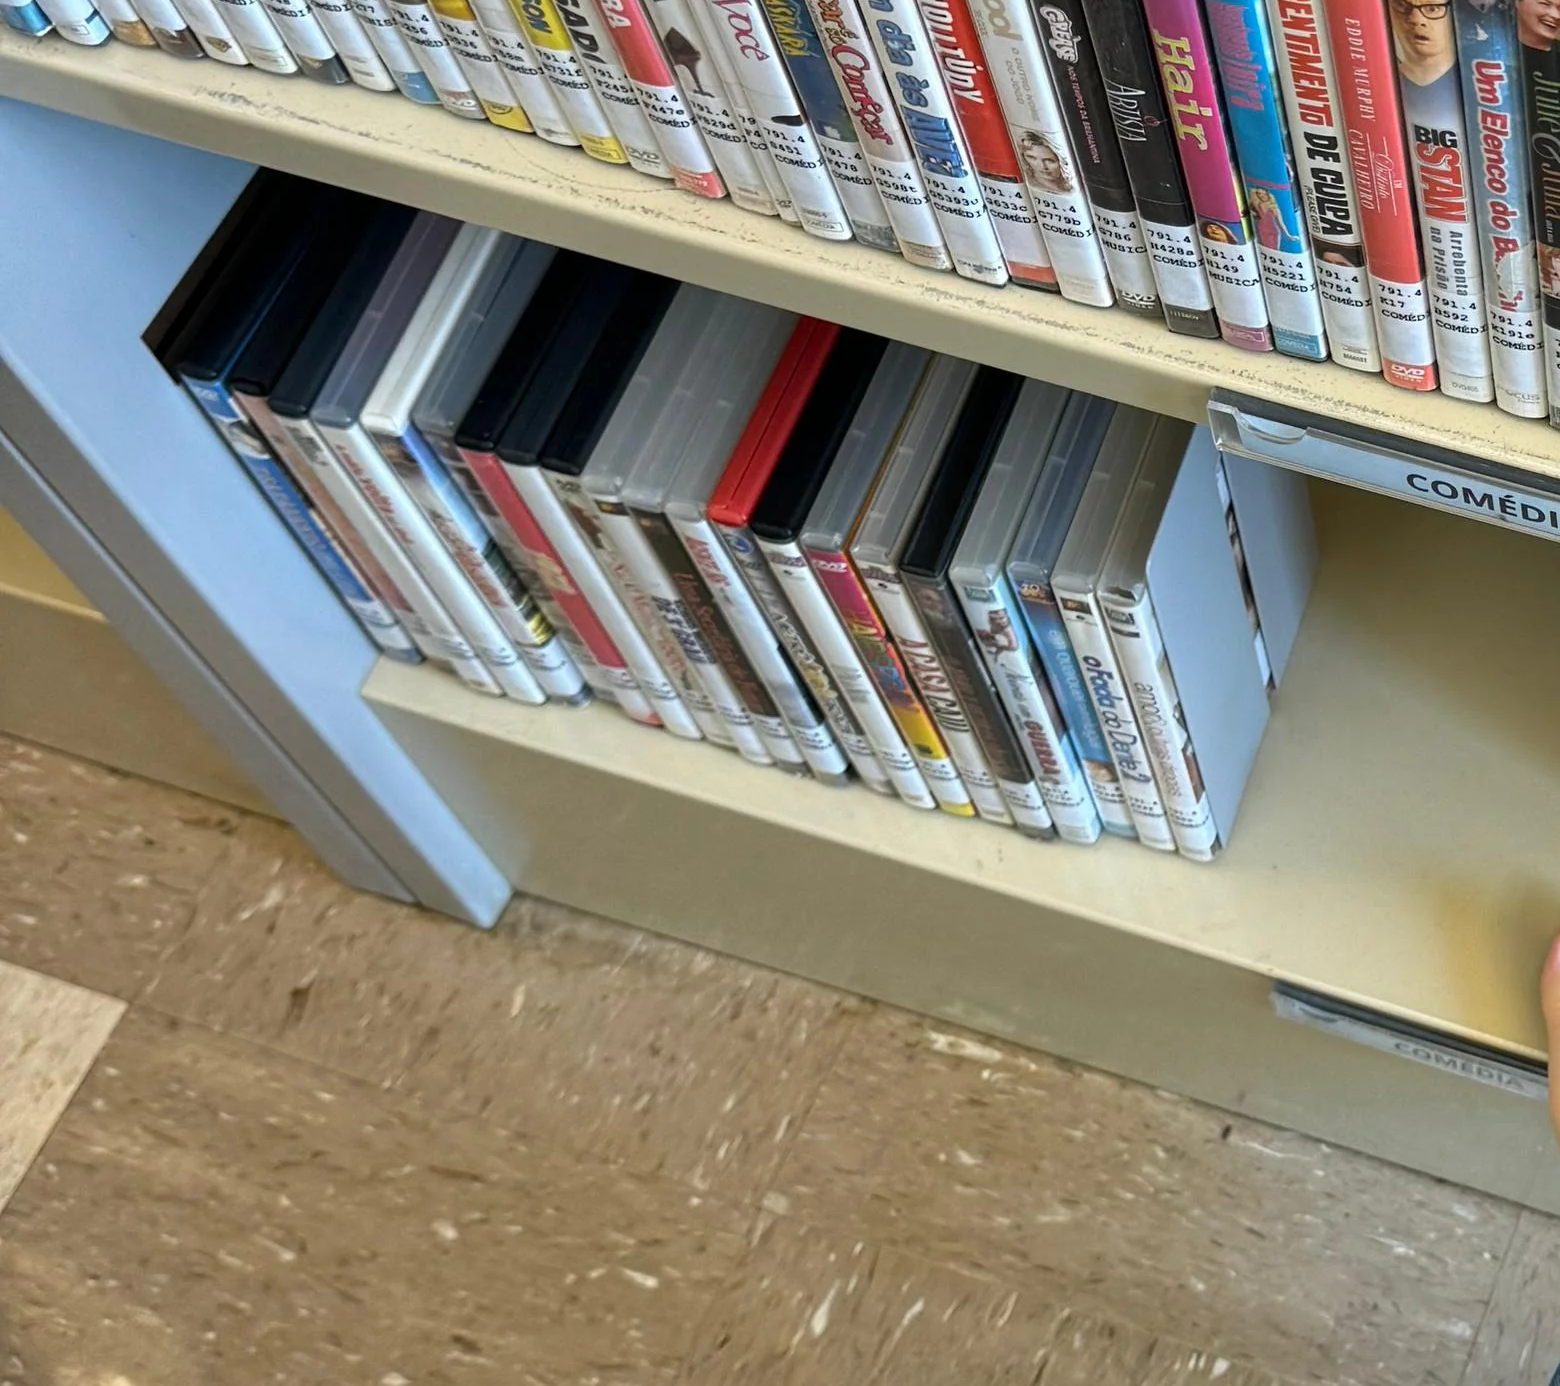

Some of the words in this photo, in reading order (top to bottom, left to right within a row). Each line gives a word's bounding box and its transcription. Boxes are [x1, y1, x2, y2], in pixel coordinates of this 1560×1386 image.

[877, 19, 916, 66] dia
[1345, 17, 1365, 63] EDDIE
[1152, 28, 1212, 150] Hair
[1354, 68, 1377, 123] MURPHY
[1472, 59, 1505, 106] Um
[1104, 78, 1147, 142] ARTISTA
[1304, 131, 1340, 163] DE
[1414, 124, 1458, 148] BIG
[1478, 108, 1511, 194] Elenco
[1348, 128, 1375, 210] CAVALHEIRO
[1415, 143, 1469, 223] STAN
[1034, 196, 1077, 213] 791.4
[1310, 167, 1353, 236] CULPA
[1488, 200, 1518, 232] do
[1148, 229, 1192, 244] 791.4
[1204, 246, 1245, 262] 791.4
[1261, 252, 1304, 269] 791.4
[1317, 266, 1359, 283] 791.4
[1378, 284, 1422, 298] 791.4
[1380, 296, 1405, 308] K17
[1433, 295, 1477, 311] 791.4
[1490, 312, 1533, 327] 791.4
